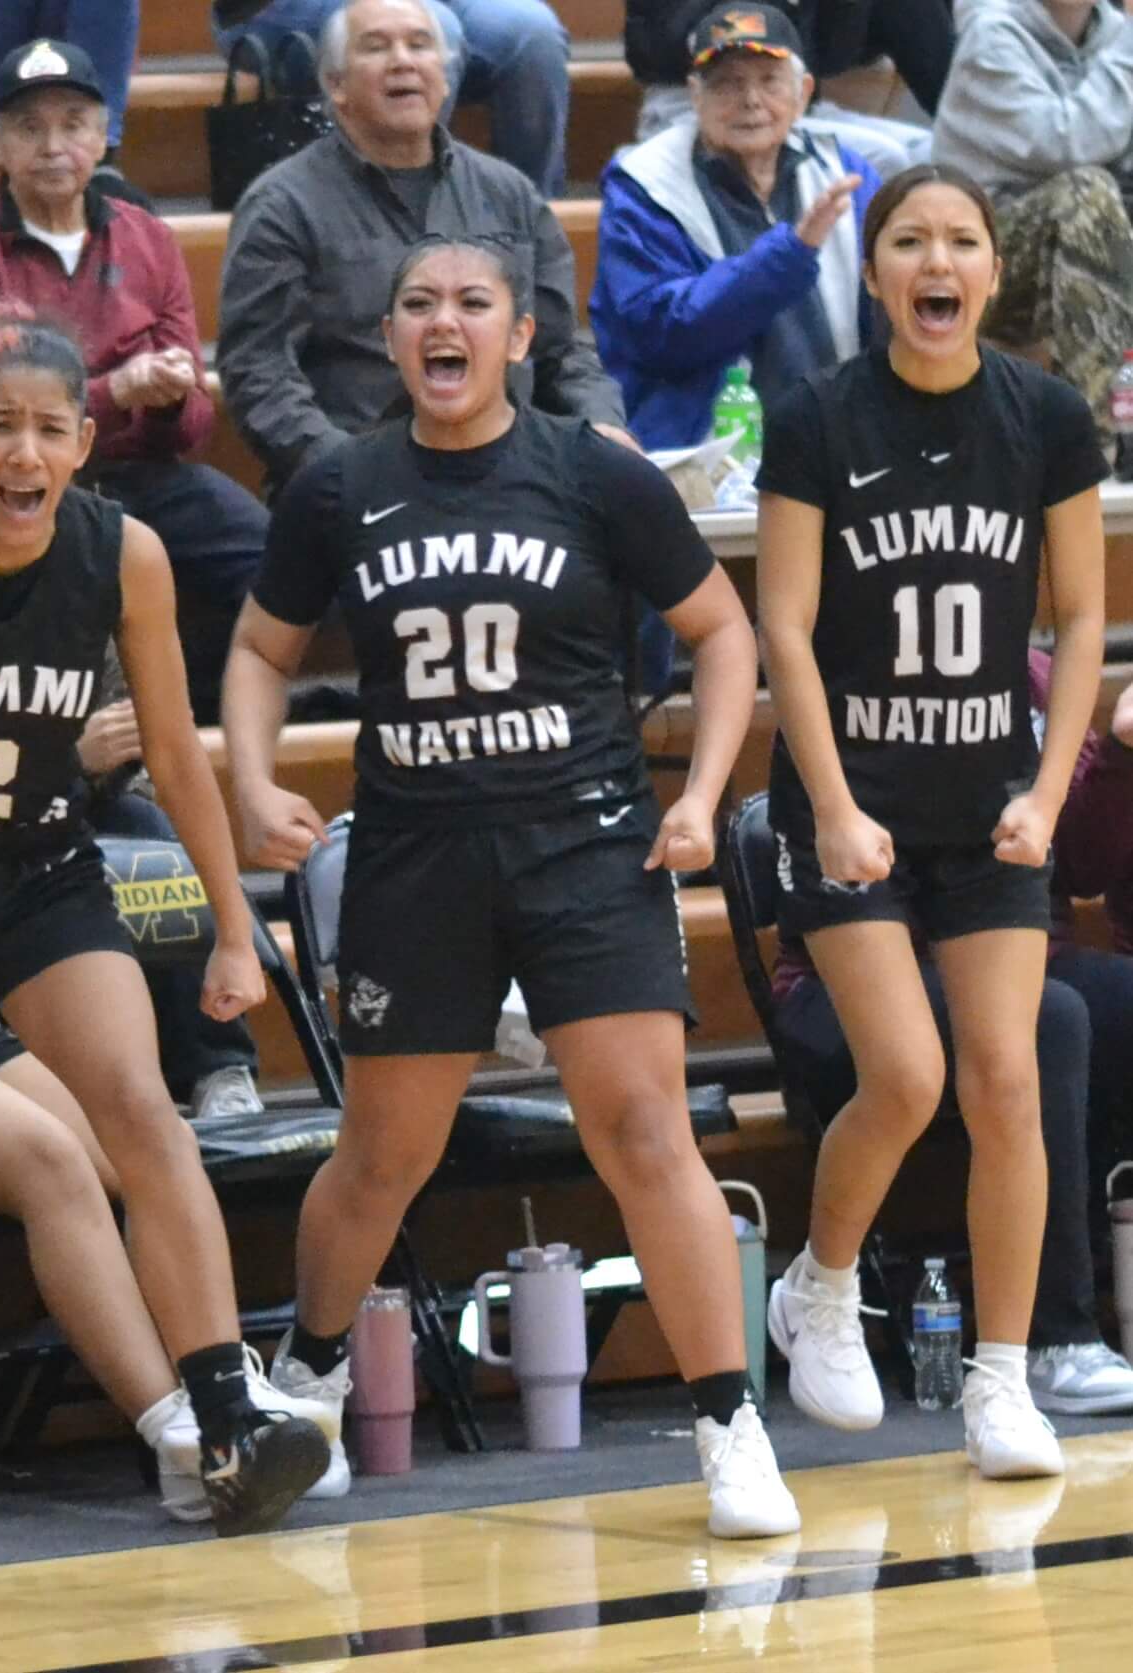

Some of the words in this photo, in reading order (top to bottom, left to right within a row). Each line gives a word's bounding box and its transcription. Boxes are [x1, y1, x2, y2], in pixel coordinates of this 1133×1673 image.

[355, 531, 569, 602] LUMMI
[841, 504, 1025, 572] LUMMI
[393, 602, 520, 700] 20
[893, 582, 982, 677] 10
[376, 703, 572, 767] NATION
[845, 690, 1012, 746] NATION
